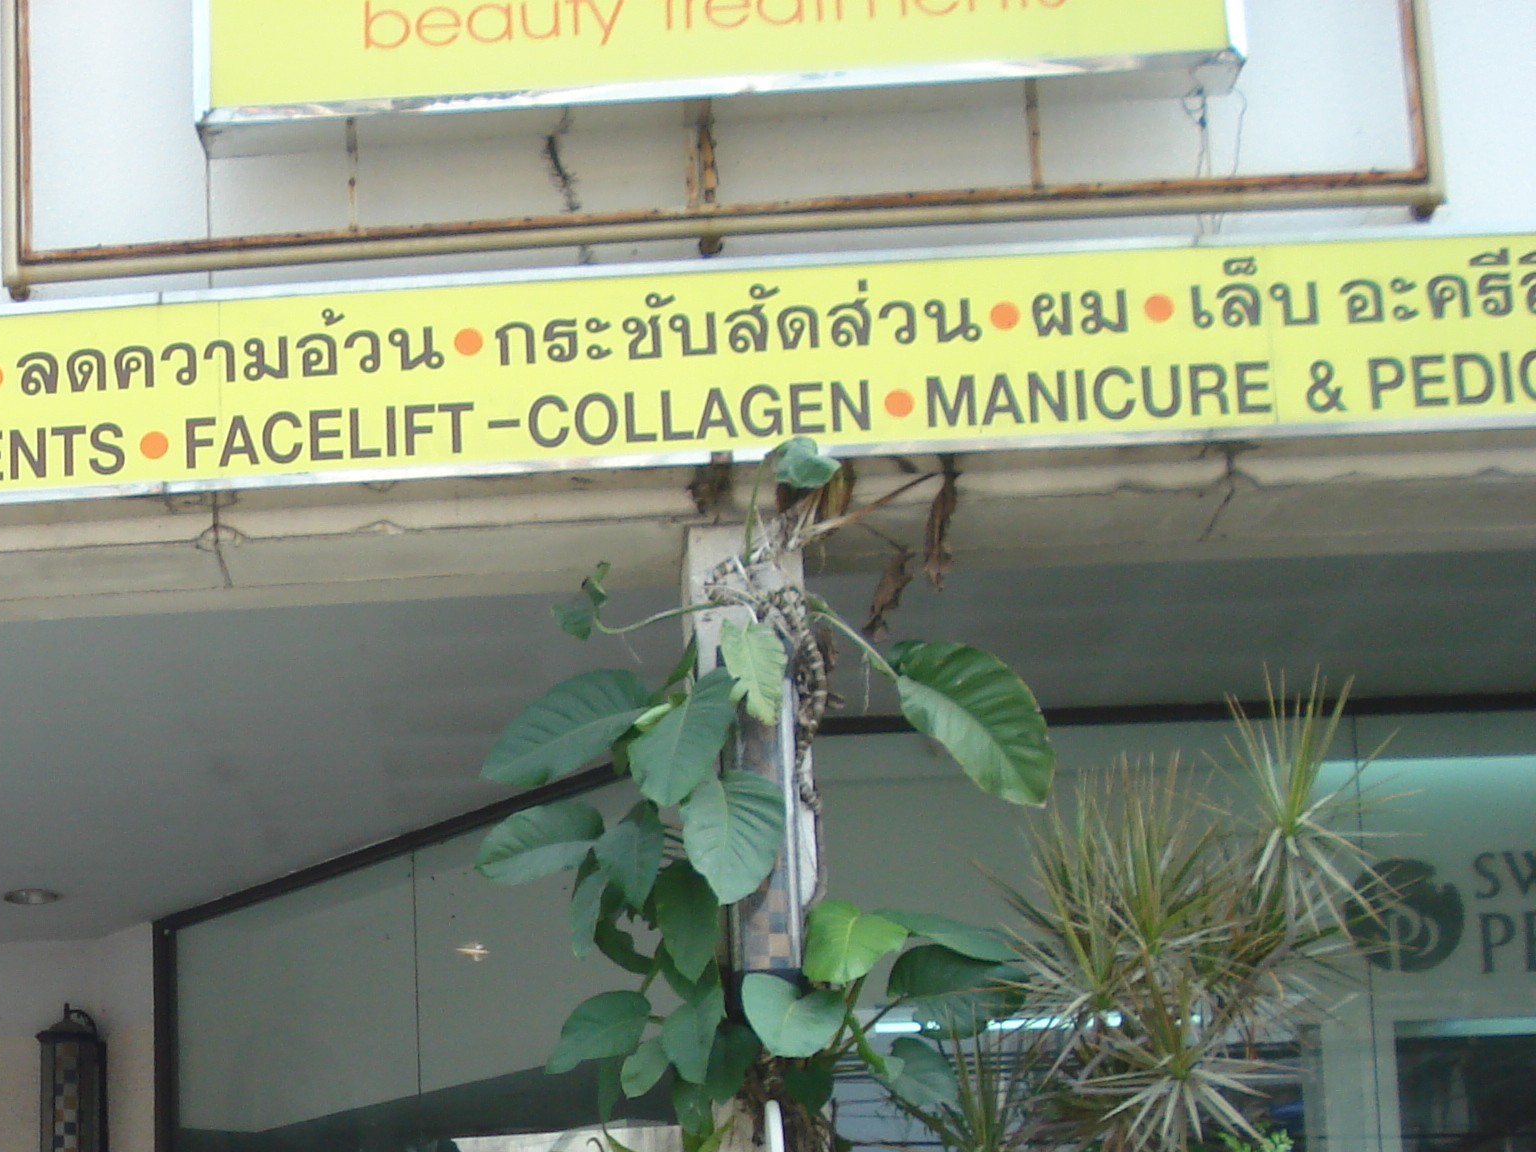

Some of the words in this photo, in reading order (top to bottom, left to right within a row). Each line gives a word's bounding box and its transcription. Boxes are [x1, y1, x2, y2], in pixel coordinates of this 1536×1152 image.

[16, 308, 445, 396] ลดความอ้วน
[495, 279, 982, 366] กระชับสัดส่วน
[1031, 288, 1128, 337] ผม
[926, 361, 1270, 427] MANICURE
[1306, 361, 1345, 413] &
